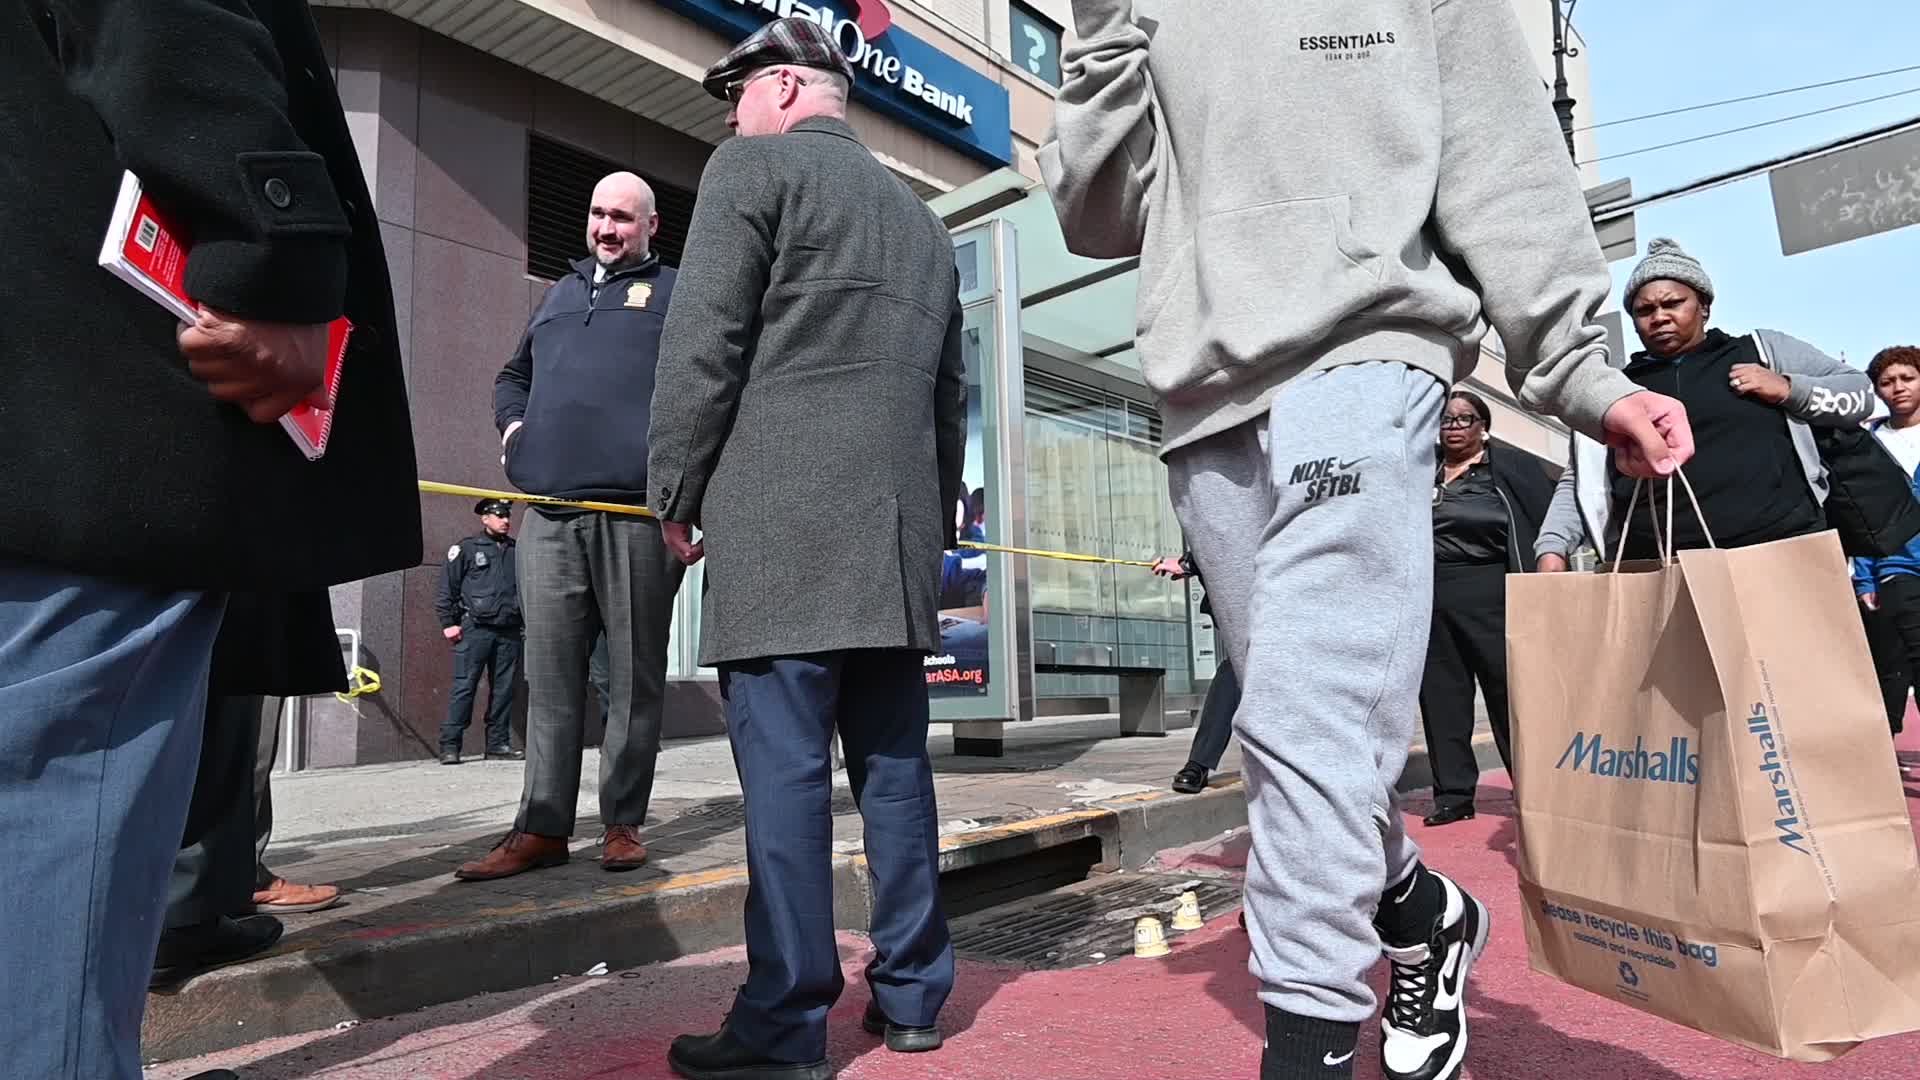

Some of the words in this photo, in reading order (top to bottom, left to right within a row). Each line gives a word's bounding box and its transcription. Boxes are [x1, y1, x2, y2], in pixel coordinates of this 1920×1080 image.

[1299, 31, 1396, 50] ESSENTIALS
[902, 65, 973, 125] Bank
[1304, 472, 1361, 502] SFTBL
[1554, 731, 1699, 784] Marshalls
[1747, 702, 1811, 856] Marshalls
[1585, 914, 1639, 942] recycle
[1643, 927, 1673, 951] this
[1676, 936, 1718, 967] bag
